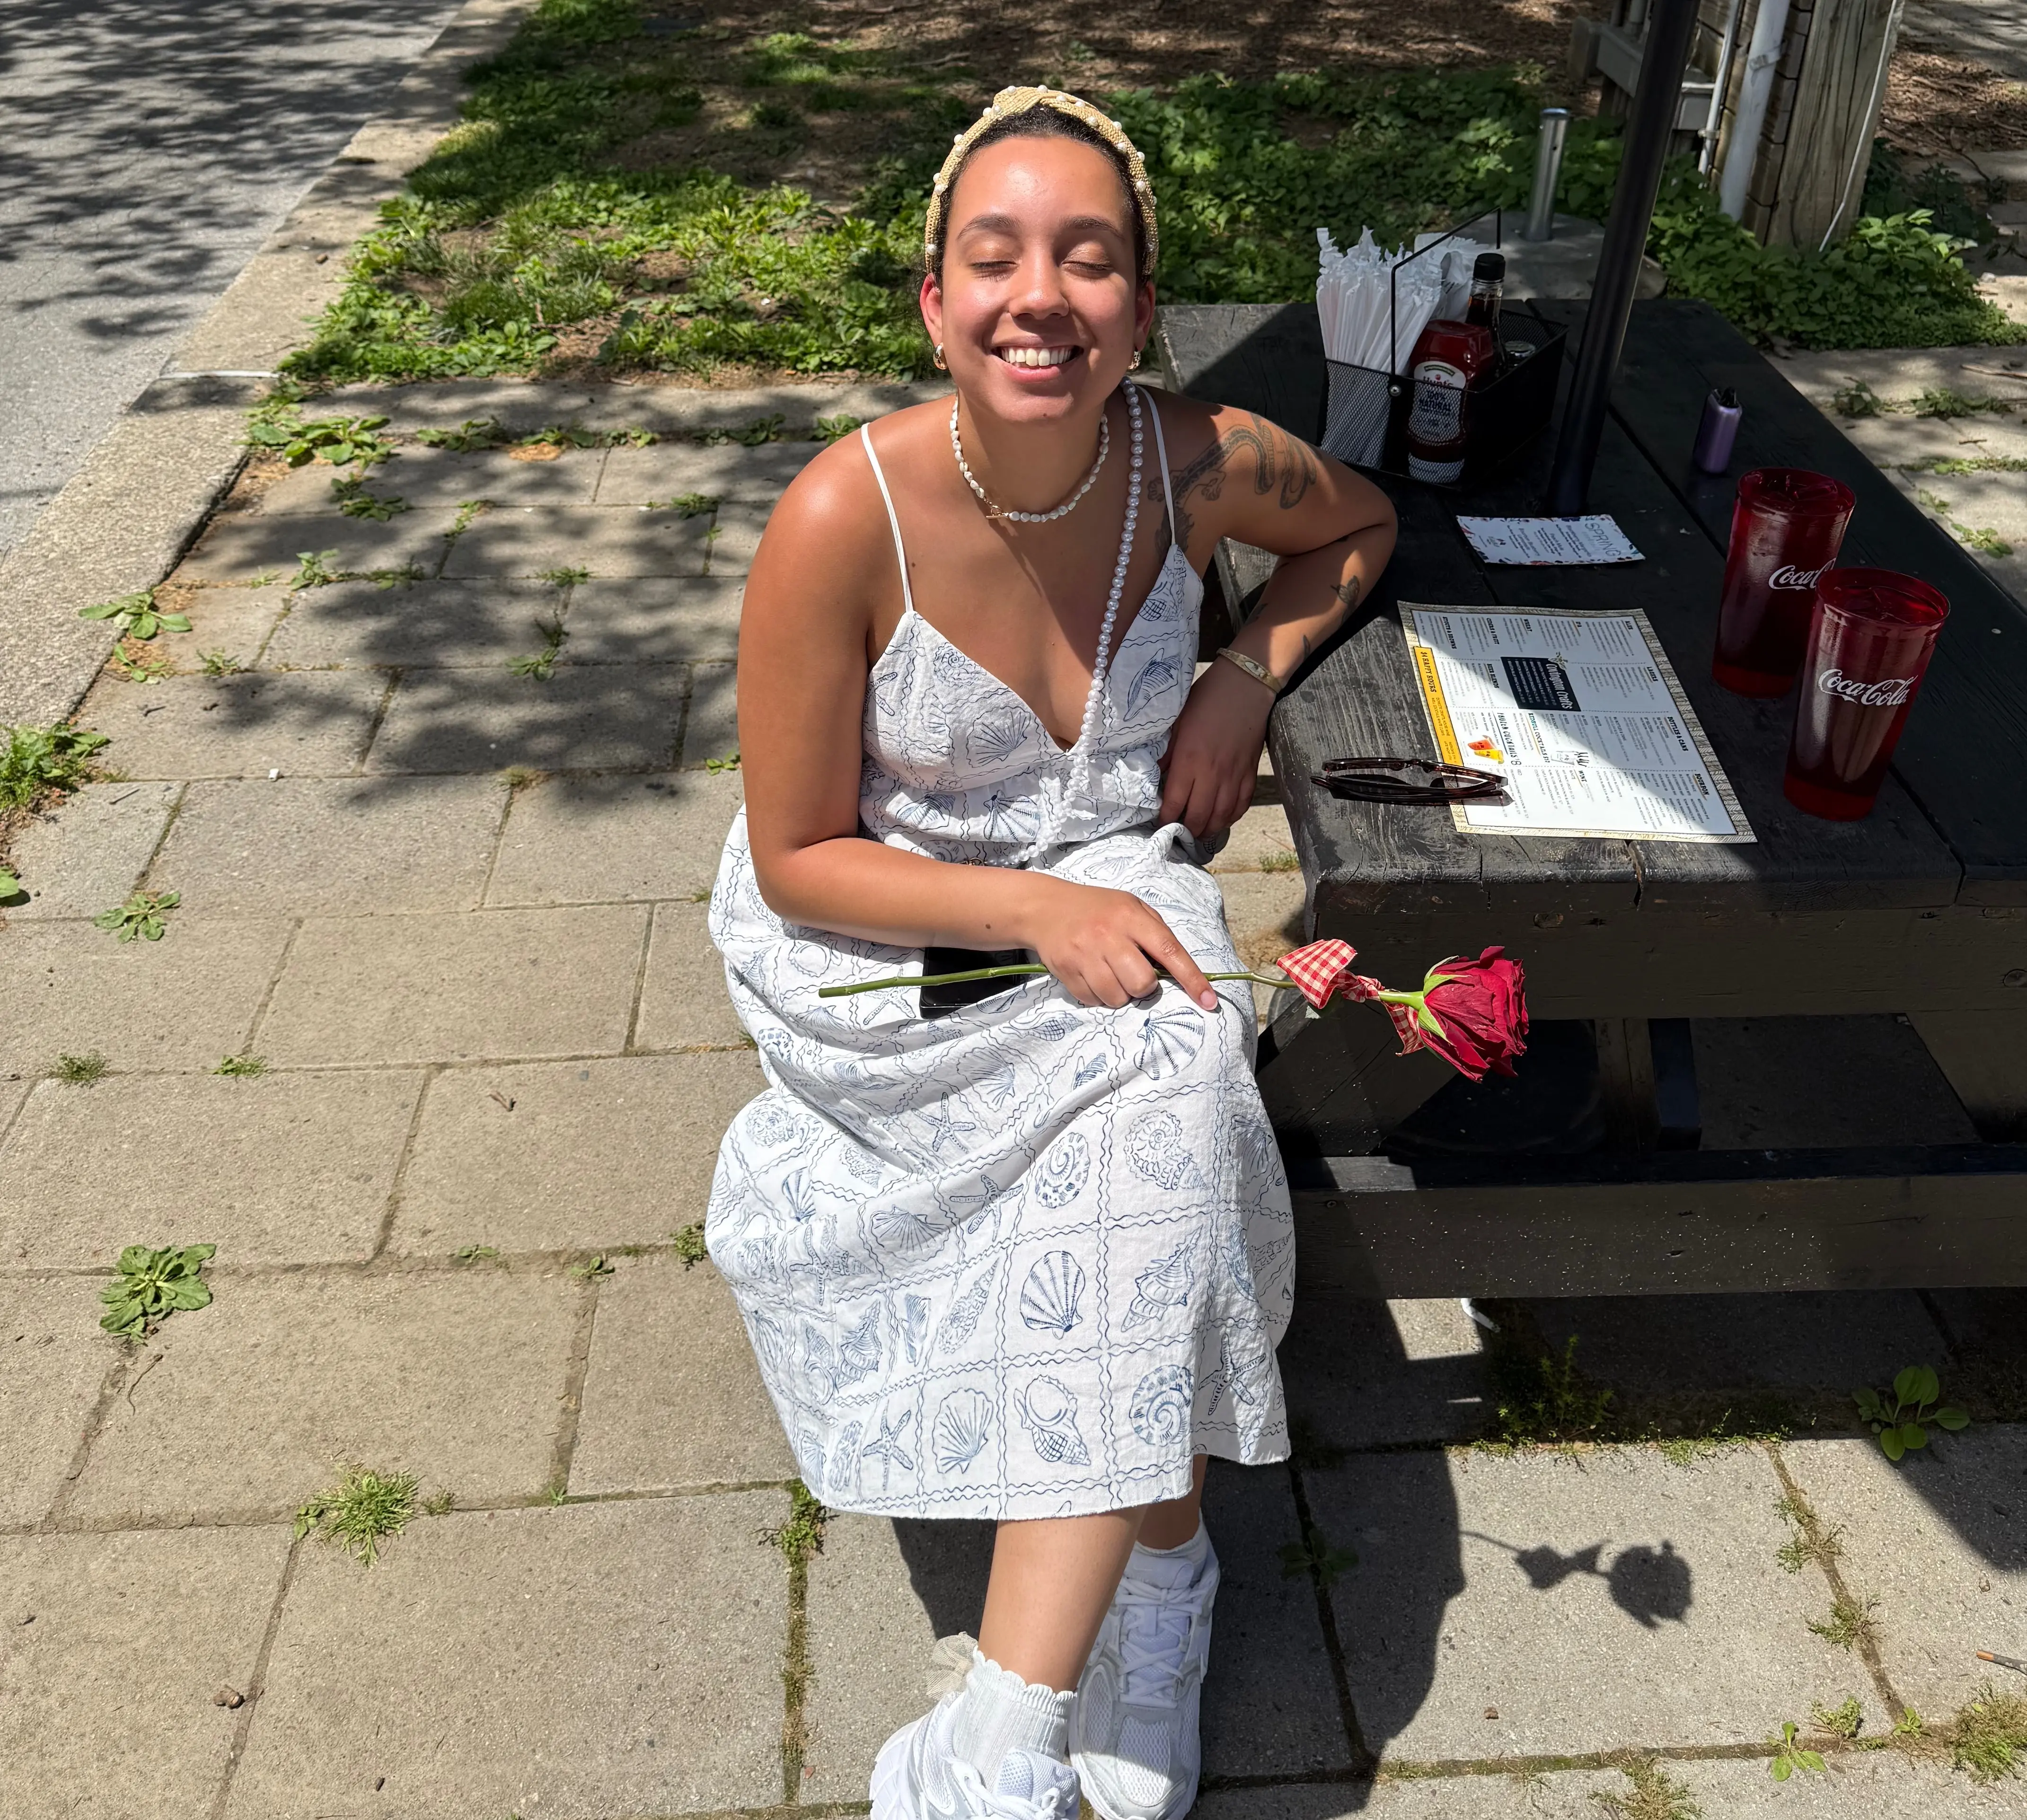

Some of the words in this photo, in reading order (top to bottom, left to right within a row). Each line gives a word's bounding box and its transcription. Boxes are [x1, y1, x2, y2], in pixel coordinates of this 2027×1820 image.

[1584, 522, 1622, 556] SPRING
[1769, 557, 1836, 590] Coca-C
[1422, 658, 1432, 675] HAPPY
[1427, 675, 1437, 693] HOURS
[1546, 664, 1565, 690] Covington
[1556, 691, 1573, 709] Crafts
[1818, 668, 1919, 706] Coca-Cola
[1667, 716, 1681, 735] BOTTLES
[1678, 739, 1689, 751] CANS
[1578, 770, 1587, 782] WINE
[1694, 773, 1710, 795] BOURBON
